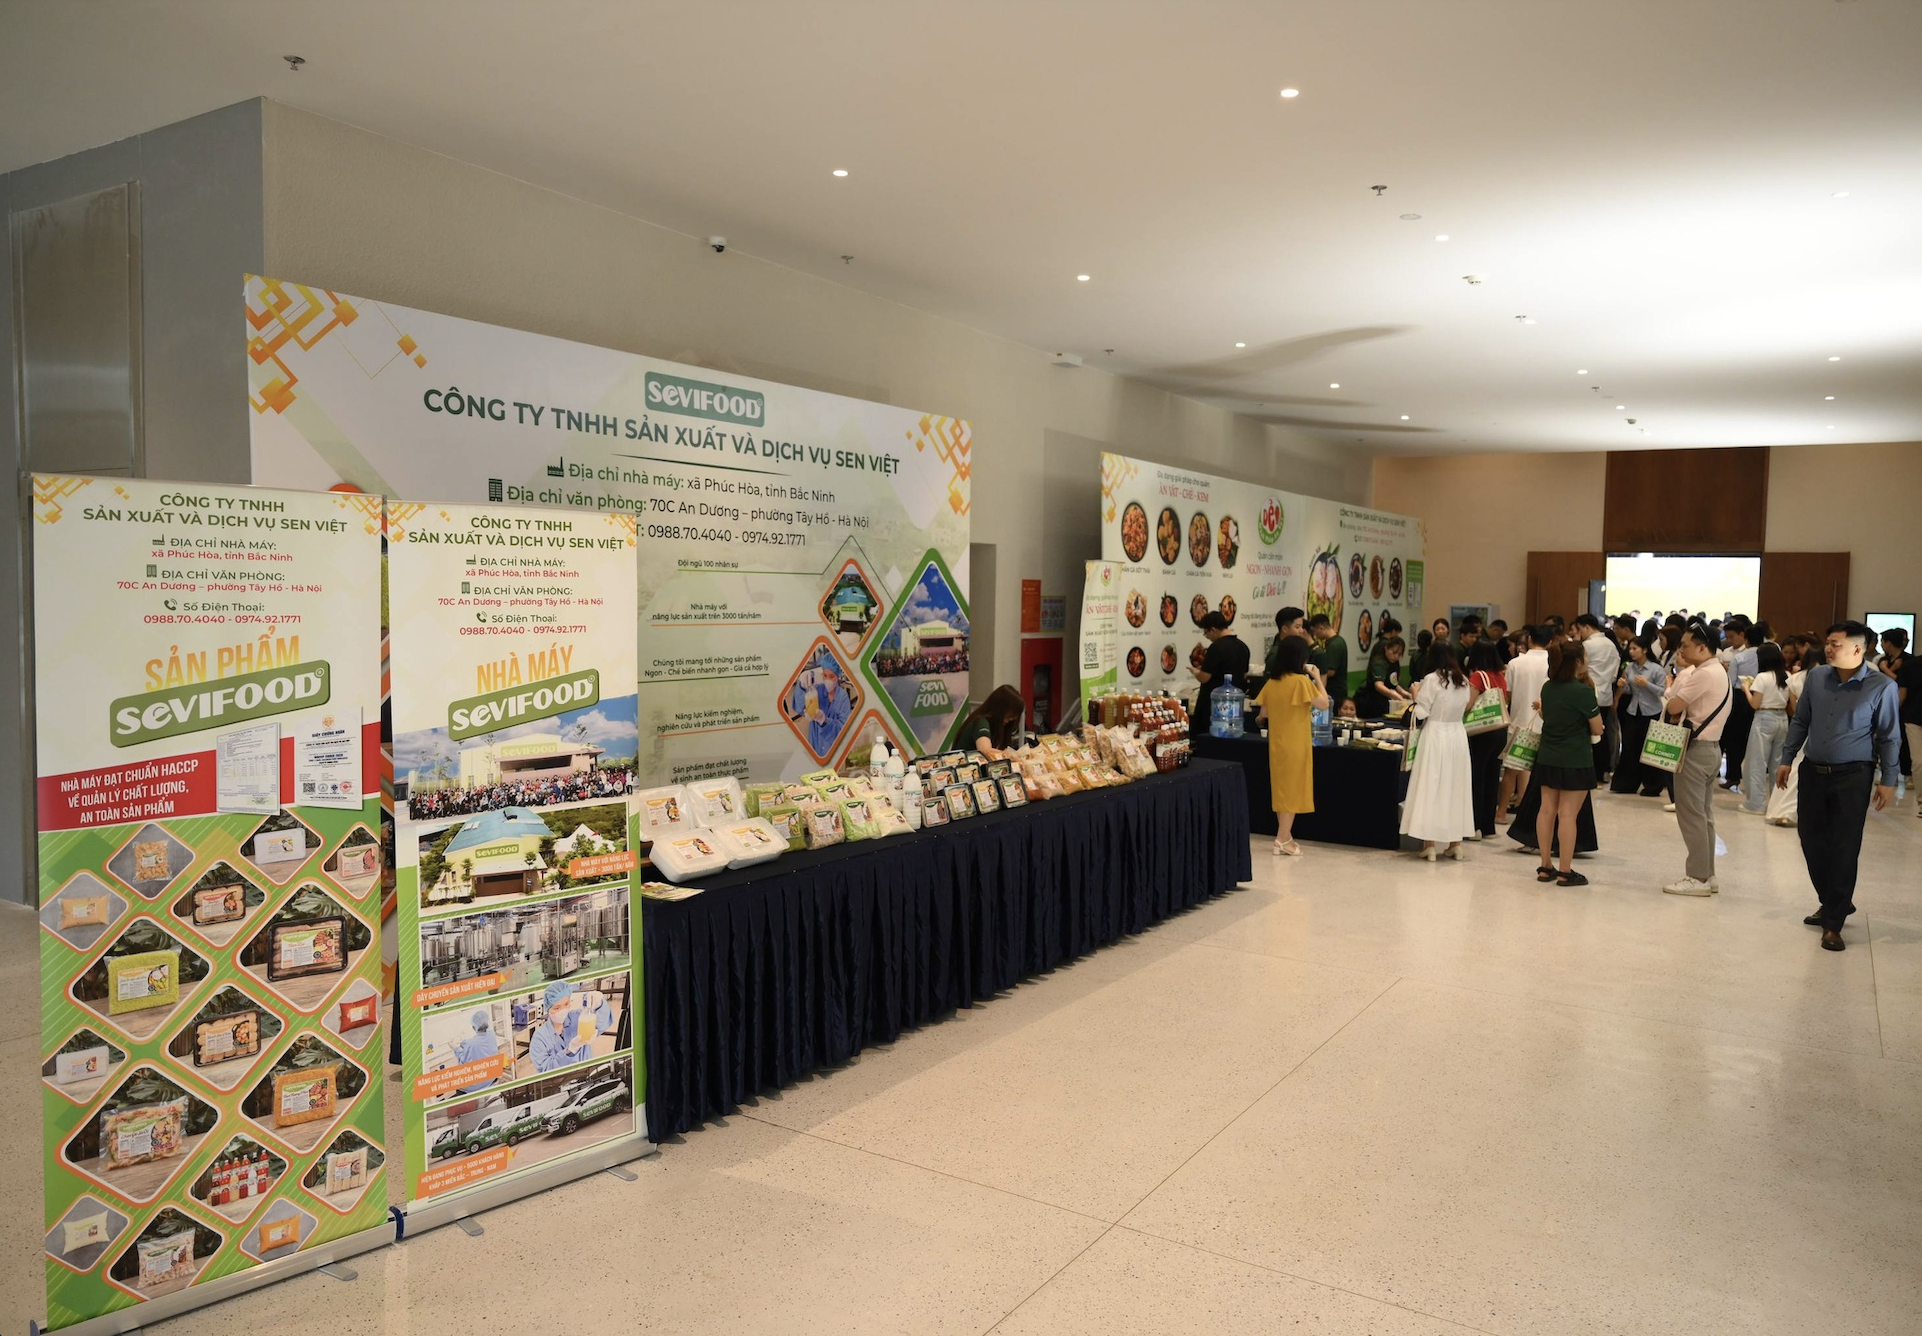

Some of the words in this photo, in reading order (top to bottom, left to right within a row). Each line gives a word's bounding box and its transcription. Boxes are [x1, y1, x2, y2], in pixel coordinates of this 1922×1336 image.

[423, 387, 506, 421] CÔNG
[513, 401, 544, 427] TY
[550, 407, 618, 437] TNHH
[625, 415, 668, 443] SẢN
[674, 424, 727, 451] XUẤT
[731, 431, 757, 456] VÀ
[762, 439, 803, 463] DỊCH
[808, 447, 832, 469] VỤ
[835, 449, 865, 470] SEN
[868, 454, 899, 477] VIỆT
[568, 463, 594, 481] Địa
[597, 464, 620, 482] chỉ
[623, 467, 649, 484] nhà
[652, 473, 684, 490] máy:
[687, 477, 701, 490] xã
[705, 477, 734, 493] Phúc
[738, 480, 763, 498] Hòa,
[766, 482, 786, 499] tỉnh
[790, 484, 809, 502] Bắc
[812, 489, 835, 503] Ninh
[160, 493, 210, 509] CÔNG
[215, 497, 235, 510] TY
[239, 498, 285, 512] TNHH
[507, 485, 534, 503] Địa
[540, 486, 562, 505] chỉ
[565, 492, 592, 507] văn
[596, 493, 647, 514] phòng:
[650, 498, 675, 513] 70C
[678, 501, 696, 515] An
[699, 503, 739, 521] Dương
[751, 506, 792, 526] phường
[795, 510, 813, 526] Tây
[815, 510, 830, 525] Hồ
[838, 513, 851, 527] Hà
[854, 515, 869, 529] Nội
[83, 504, 121, 522] SẢN
[127, 508, 174, 525] XUẤT
[179, 512, 202, 526] VÀ
[208, 514, 248, 529] DỊCH
[252, 517, 275, 531] VỤ
[281, 518, 311, 531] SEN
[316, 520, 348, 535] VIỆT
[471, 515, 511, 530] CÔNG
[515, 519, 531, 530] TY
[535, 520, 572, 531] TNHH
[171, 537, 192, 550] ĐỊA
[196, 536, 217, 548] CHỈ
[221, 538, 246, 549] NHÀ
[249, 539, 277, 551] MÁY:
[409, 528, 439, 543] SẢN
[444, 531, 482, 545] XUẤT
[485, 533, 505, 545] VÀ
[509, 536, 543, 549] DỊCH
[547, 537, 565, 550] VỤ
[569, 538, 594, 548] SEN
[597, 539, 624, 551] VIỆT
[648, 524, 732, 543] 0988.70.4040
[742, 530, 806, 546] 0974.92.1771
[152, 550, 164, 558] xã
[167, 549, 193, 559] Phúc
[197, 551, 221, 561] Hòa,
[225, 550, 245, 560] tỉnh
[248, 550, 266, 561] Bắc
[269, 553, 293, 561] Ninh
[480, 557, 497, 567] ĐỊA
[500, 556, 517, 566] CHỈ
[520, 557, 541, 567] NHÀ
[543, 557, 565, 567] MÁY:
[162, 570, 183, 581] ĐỊA
[187, 568, 208, 580] CHỈ
[210, 569, 237, 580] VĂN
[240, 569, 285, 582] PHÒNG:
[465, 569, 476, 577] xã
[478, 568, 499, 577] Phúc
[502, 569, 521, 579] Hòa,
[523, 569, 540, 578] tỉnh
[543, 569, 557, 578] Bắc
[560, 570, 579, 578] Ninh
[117, 582, 139, 591] 70C
[142, 582, 157, 590] An
[160, 582, 195, 593] Dương
[207, 581, 245, 594] phường
[247, 582, 265, 594] Tây
[268, 582, 283, 592] Hồ
[292, 583, 304, 592] Hà
[307, 583, 322, 593] Nội
[474, 587, 491, 596] ĐỊA
[494, 585, 511, 595] CHỈ
[513, 586, 534, 595] VĂN
[536, 586, 572, 596] PHÒNG:
[183, 600, 198, 611] Số
[201, 602, 228, 612] Điện
[231, 602, 265, 613] Thoại:
[143, 615, 226, 624] 0988.70.4040
[234, 615, 301, 624] 0974.92.1771
[492, 613, 504, 623] Số
[506, 614, 528, 623] Điện
[530, 614, 557, 623] Thoại:
[459, 626, 525, 636] 0988.70.4040
[533, 625, 586, 634] 0974.92.1771
[145, 645, 206, 693] SẢN
[218, 626, 300, 679] PHẨM
[477, 651, 522, 695] NHÀ
[529, 642, 573, 681] MÁY
[60, 780, 79, 793] NHÀ
[81, 775, 101, 790] MÁY
[104, 771, 122, 787] ĐẠT
[125, 763, 159, 784] CHUẨN
[161, 759, 199, 776] HACCP
[68, 794, 80, 808] VỀ
[82, 789, 107, 807] QUẢN
[109, 788, 121, 804] LÝ
[123, 784, 149, 802] CHẤT
[151, 780, 190, 800] LƯỢNG,
[80, 811, 93, 825] AN
[96, 806, 120, 823] TOÀN
[122, 802, 142, 819] SẢN
[144, 798, 174, 816] PHẨM
